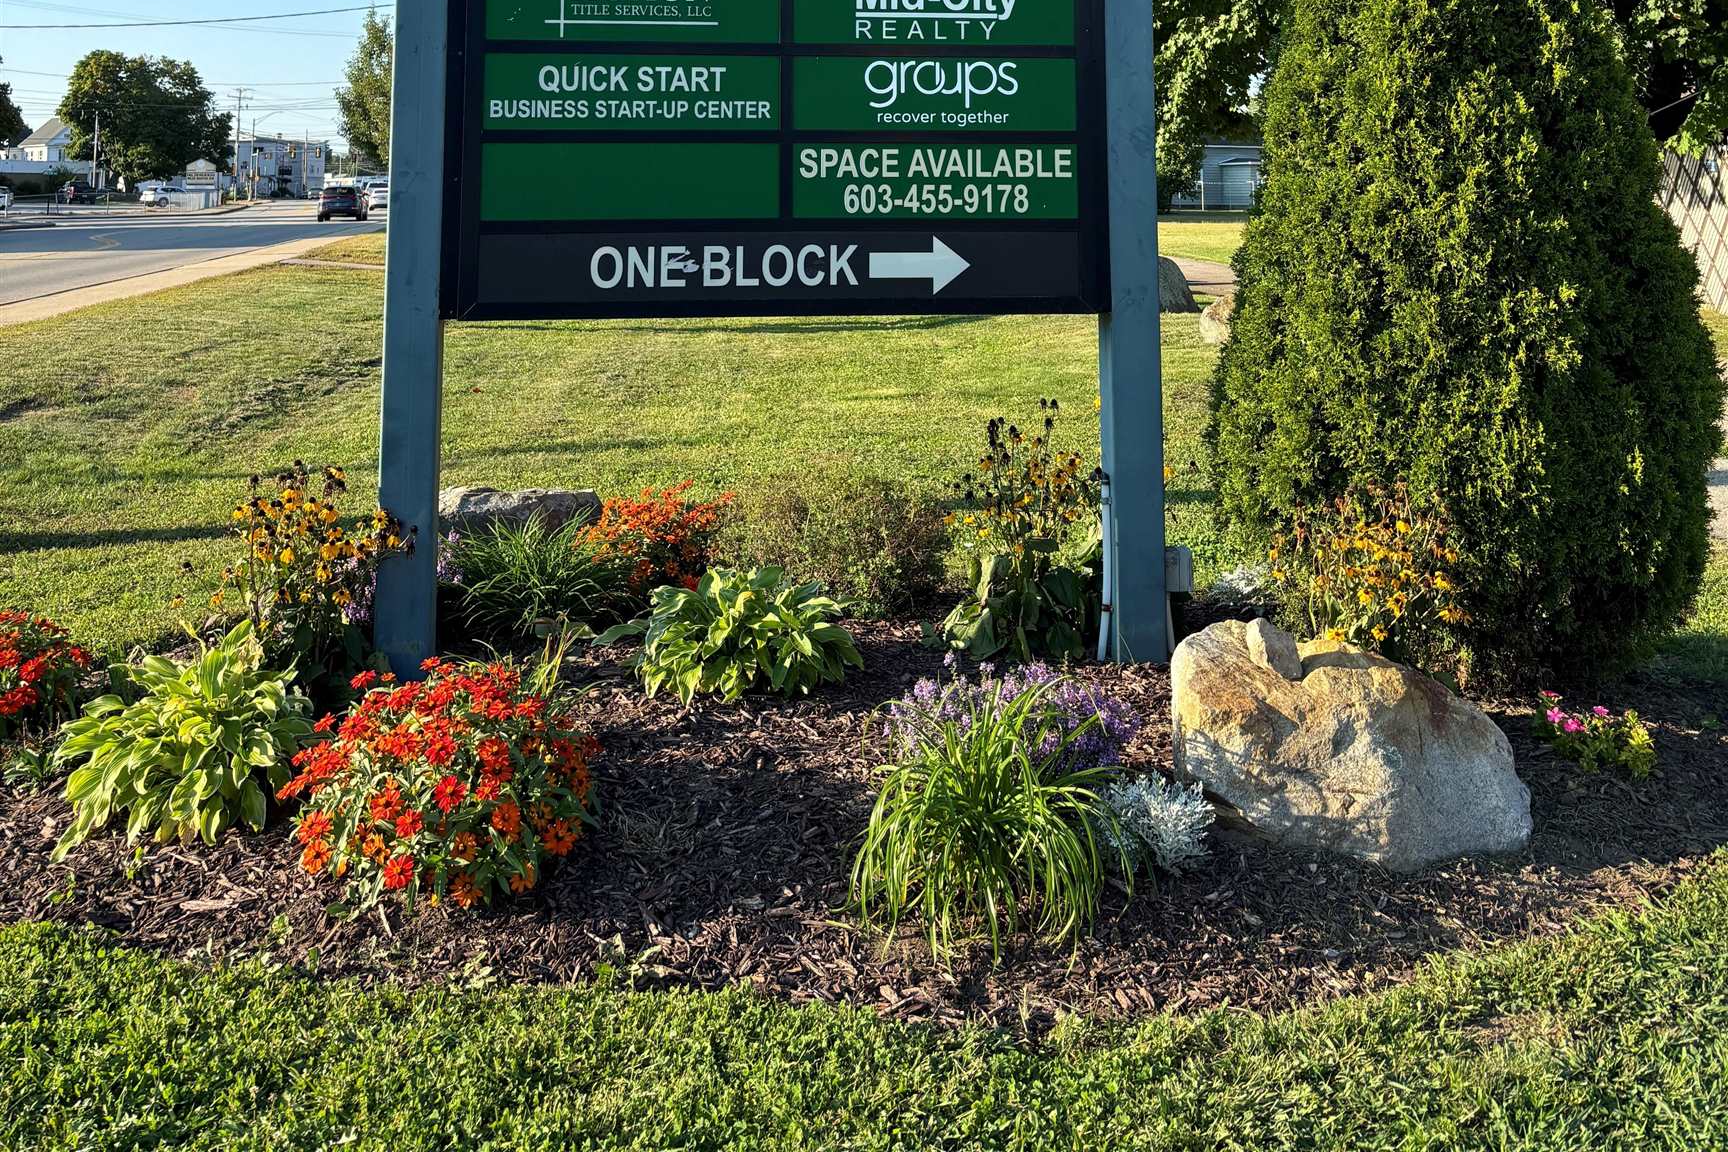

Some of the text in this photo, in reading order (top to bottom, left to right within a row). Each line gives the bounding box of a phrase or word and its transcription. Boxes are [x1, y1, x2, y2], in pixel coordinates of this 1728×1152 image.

[570, 3, 712, 19] TITLE SERVICES, LLC
[855, 19, 996, 41] REALTY
[538, 64, 727, 94] QUICK START
[864, 60, 1019, 109] groups
[489, 99, 771, 119] BUSINESS START-UP CENTER
[876, 109, 1009, 127] recover together
[799, 148, 1073, 179] SPACE AVAILABLE
[843, 183, 1029, 214] 603-455-9178
[590, 244, 859, 289] ONE BLOCK
